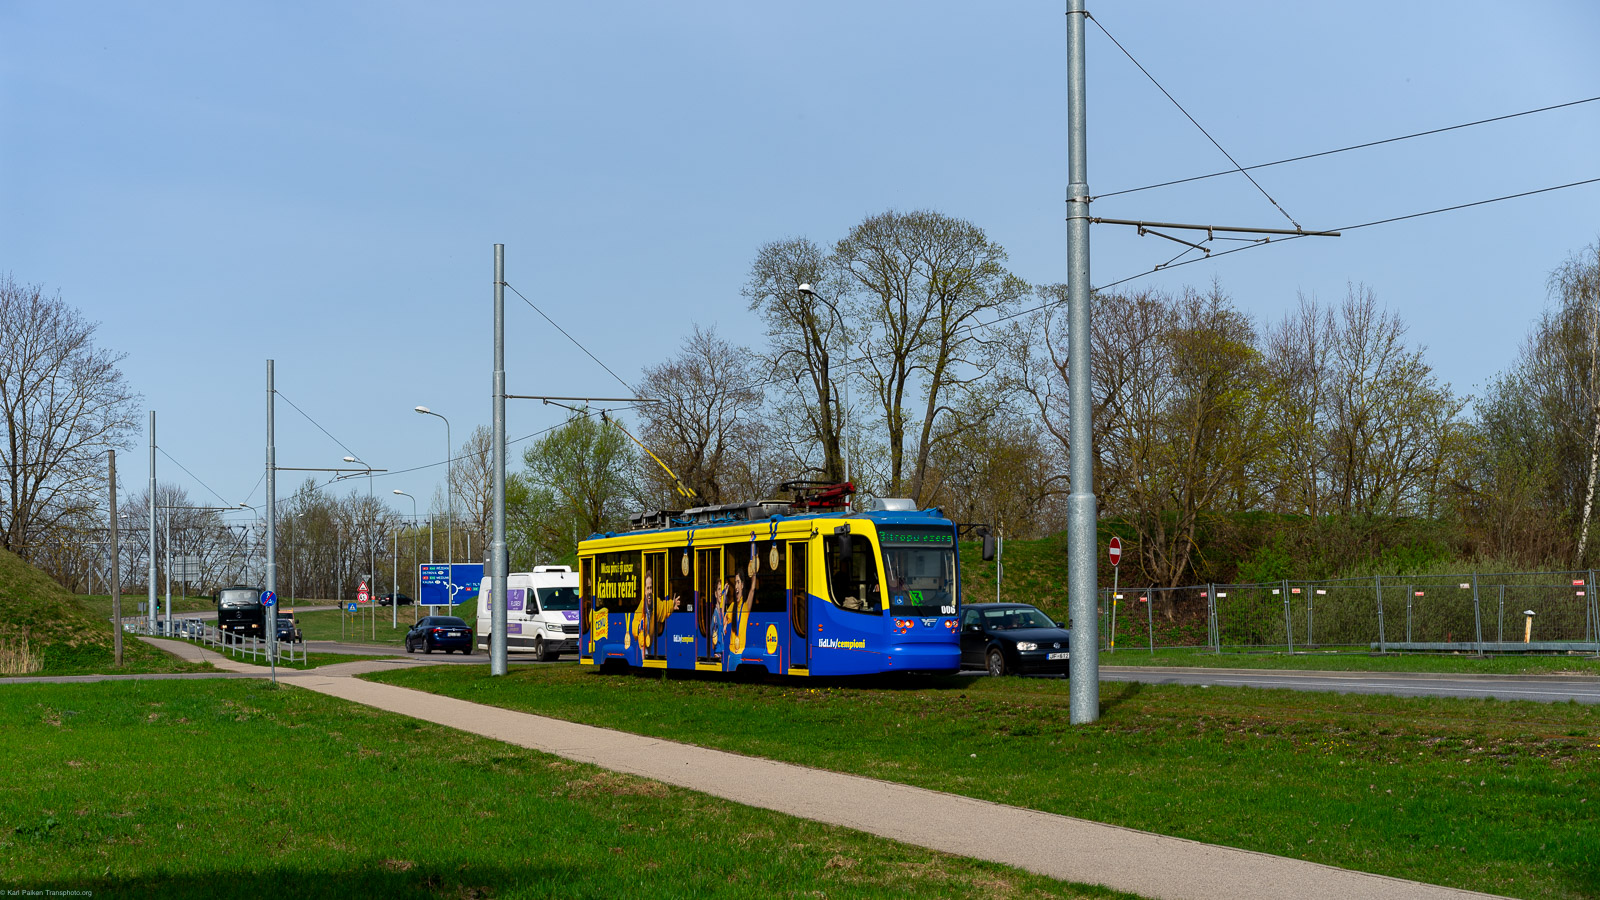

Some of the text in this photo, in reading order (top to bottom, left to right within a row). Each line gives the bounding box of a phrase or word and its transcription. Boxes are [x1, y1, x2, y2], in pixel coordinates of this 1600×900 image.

[597, 574, 637, 599] katru reizi!
[941, 605, 956, 614] 006
